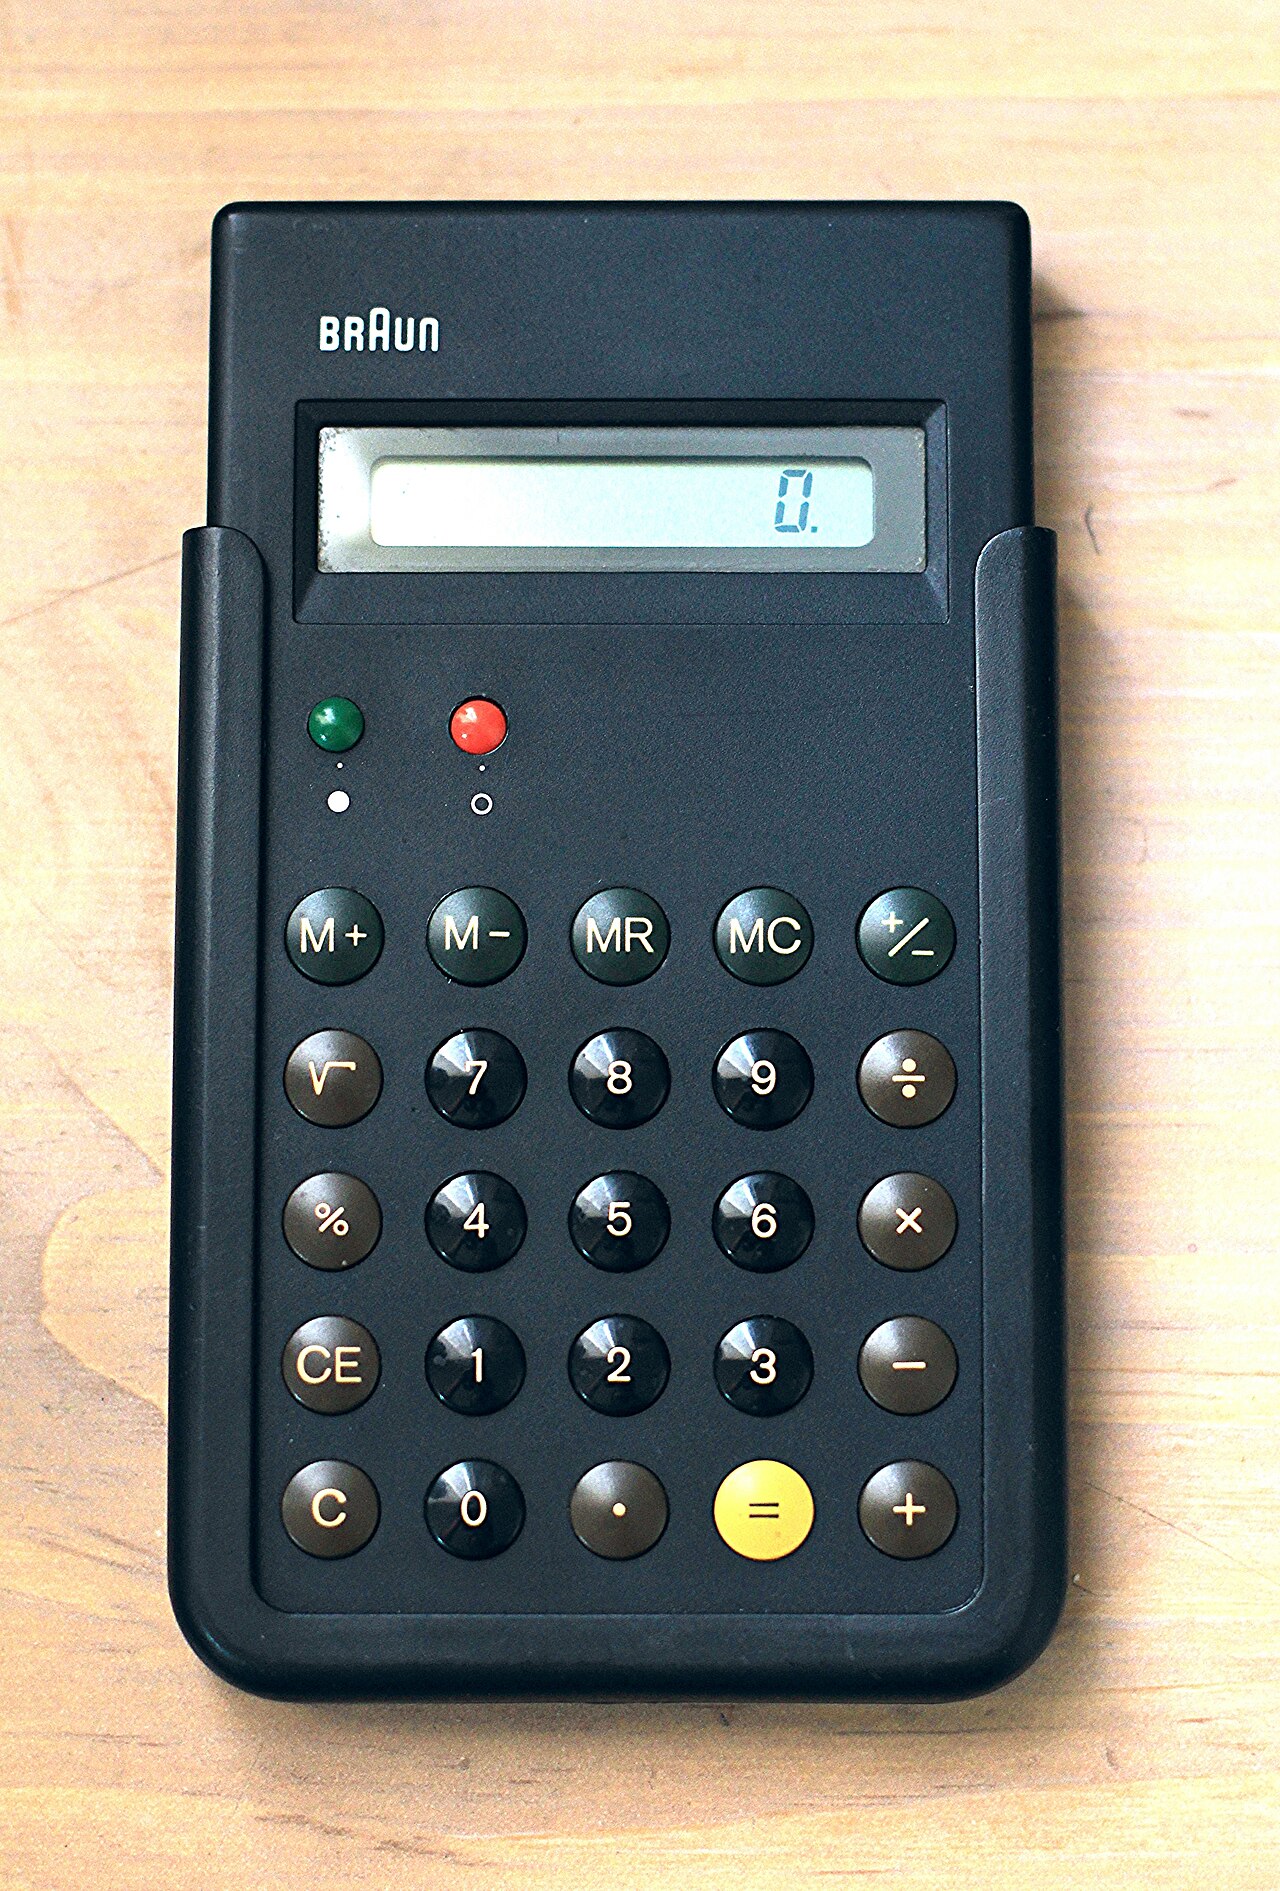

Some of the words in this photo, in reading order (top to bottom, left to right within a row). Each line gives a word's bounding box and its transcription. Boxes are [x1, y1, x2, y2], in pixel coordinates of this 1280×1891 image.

[319, 307, 439, 352] BRAUN
[585, 918, 654, 953] MR
[729, 916, 802, 955] MC
[463, 1060, 489, 1095] 7
[606, 1060, 633, 1095] 8
[750, 1060, 776, 1095] 9
[313, 1202, 349, 1237] %
[463, 1202, 490, 1238] 4
[606, 1201, 632, 1236] 5
[751, 1202, 776, 1238] 6
[295, 1344, 362, 1384] CE
[470, 1349, 483, 1383] 1
[606, 1346, 632, 1383] 2
[750, 1347, 776, 1384] 3
[311, 1489, 346, 1527] C
[460, 1490, 488, 1526] 0
